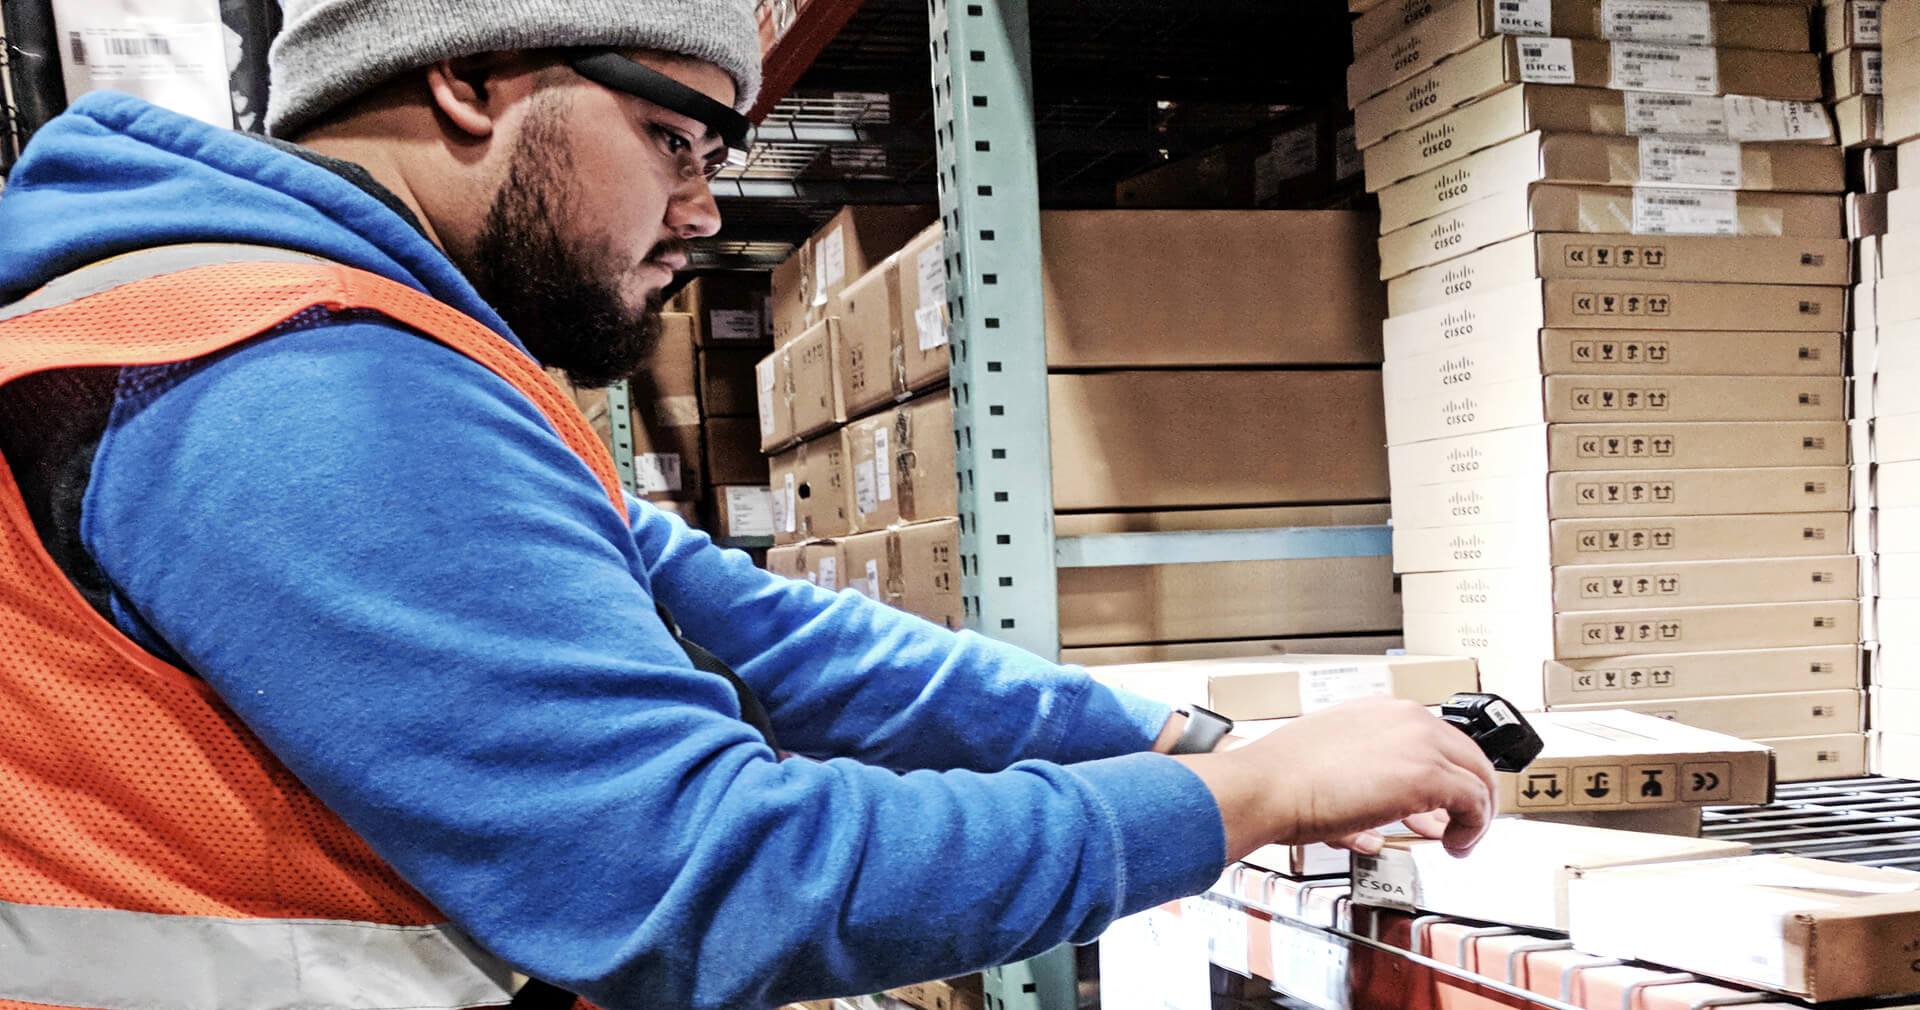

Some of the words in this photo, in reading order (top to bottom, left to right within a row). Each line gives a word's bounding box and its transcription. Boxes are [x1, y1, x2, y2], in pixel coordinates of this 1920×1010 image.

[1501, 17, 1544, 28] BRCK
[1525, 63, 1567, 72] BRCK
[1409, 94, 1437, 113] CISCO
[1422, 138, 1452, 157] CISCO
[1438, 183, 1468, 201] CISCO
[1434, 234, 1462, 250] CISCO
[1445, 280, 1472, 295] CISCO
[1444, 324, 1473, 339] CISCO
[1442, 371, 1472, 385] CISCO
[1446, 413, 1475, 425] CISCO
[1450, 461, 1479, 472] CISCO
[1452, 505, 1480, 516] CISCO
[1453, 550, 1482, 560] CISCO
[1459, 594, 1487, 603] CISCO
[1461, 638, 1488, 647] CISCO
